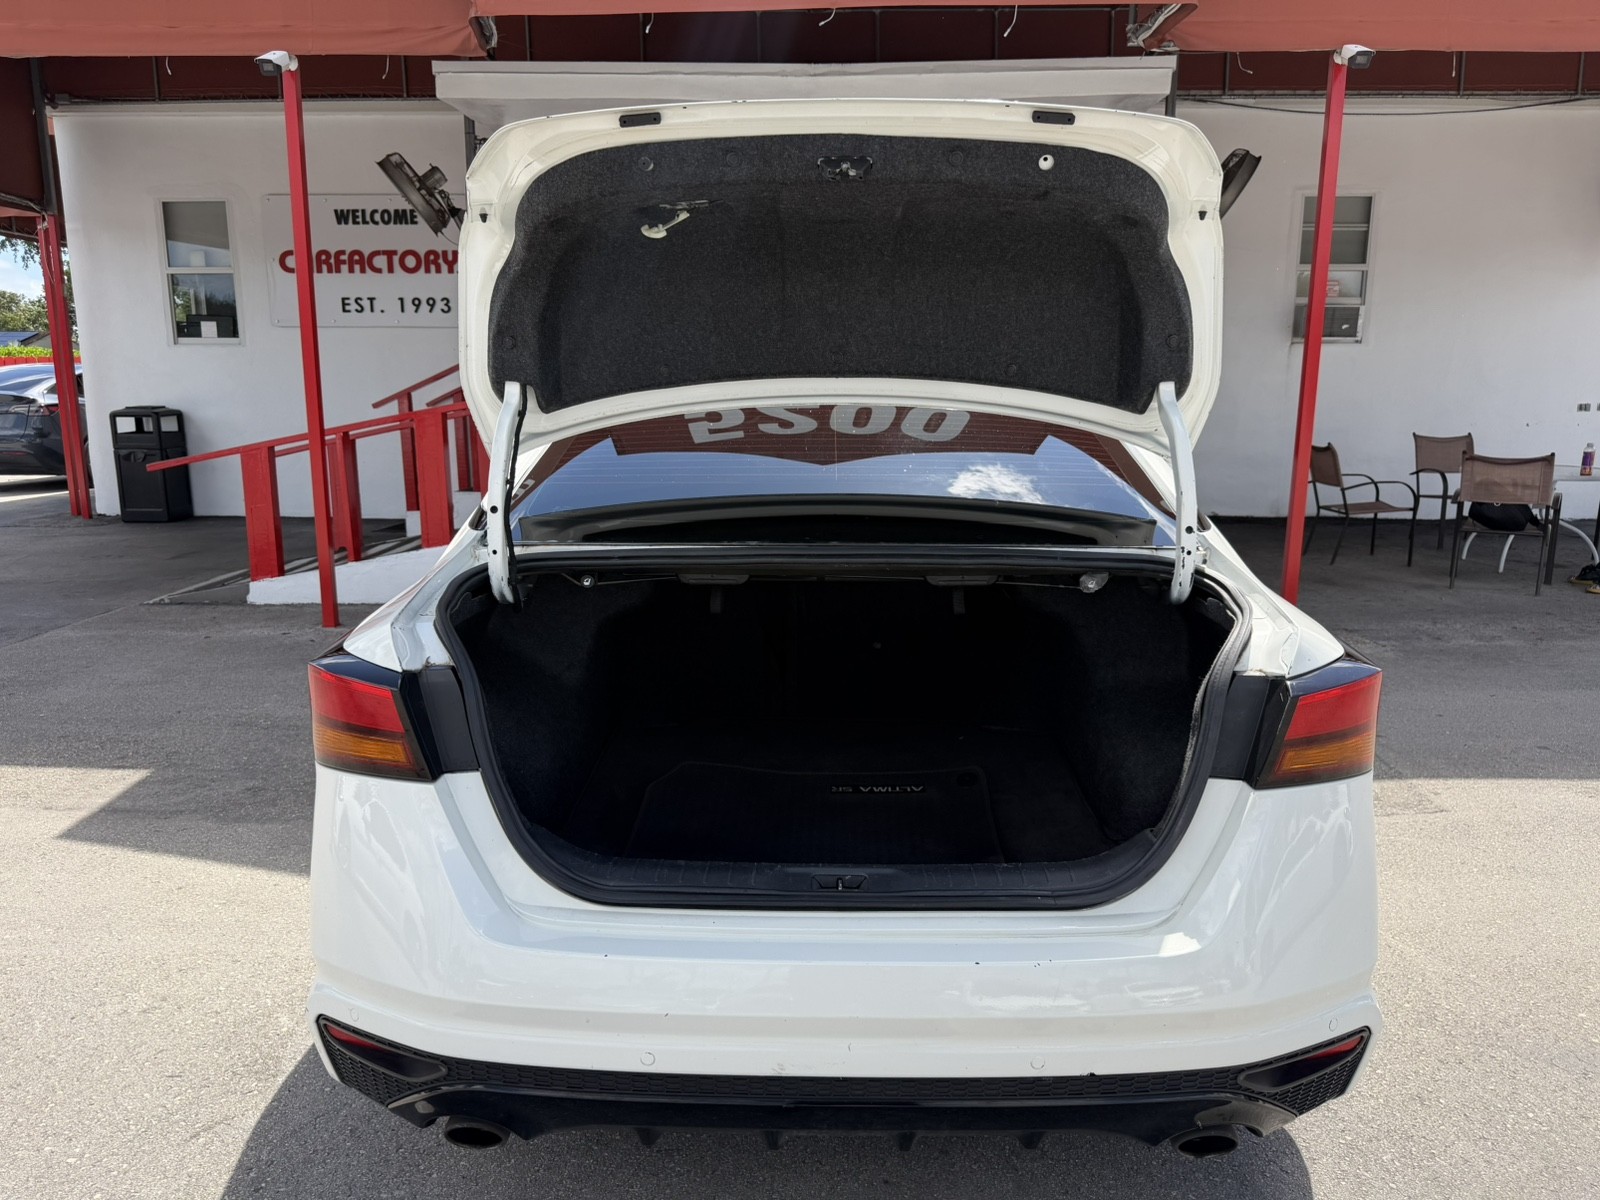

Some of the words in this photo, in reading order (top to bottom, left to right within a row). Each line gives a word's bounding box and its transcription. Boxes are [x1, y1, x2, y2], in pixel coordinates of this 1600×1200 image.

[333, 208, 418, 225] WELCOME
[278, 249, 459, 274] CRFACTORY
[341, 297, 385, 313] EST.
[398, 297, 452, 313] 1993
[859, 785, 924, 793] ALTIMA
